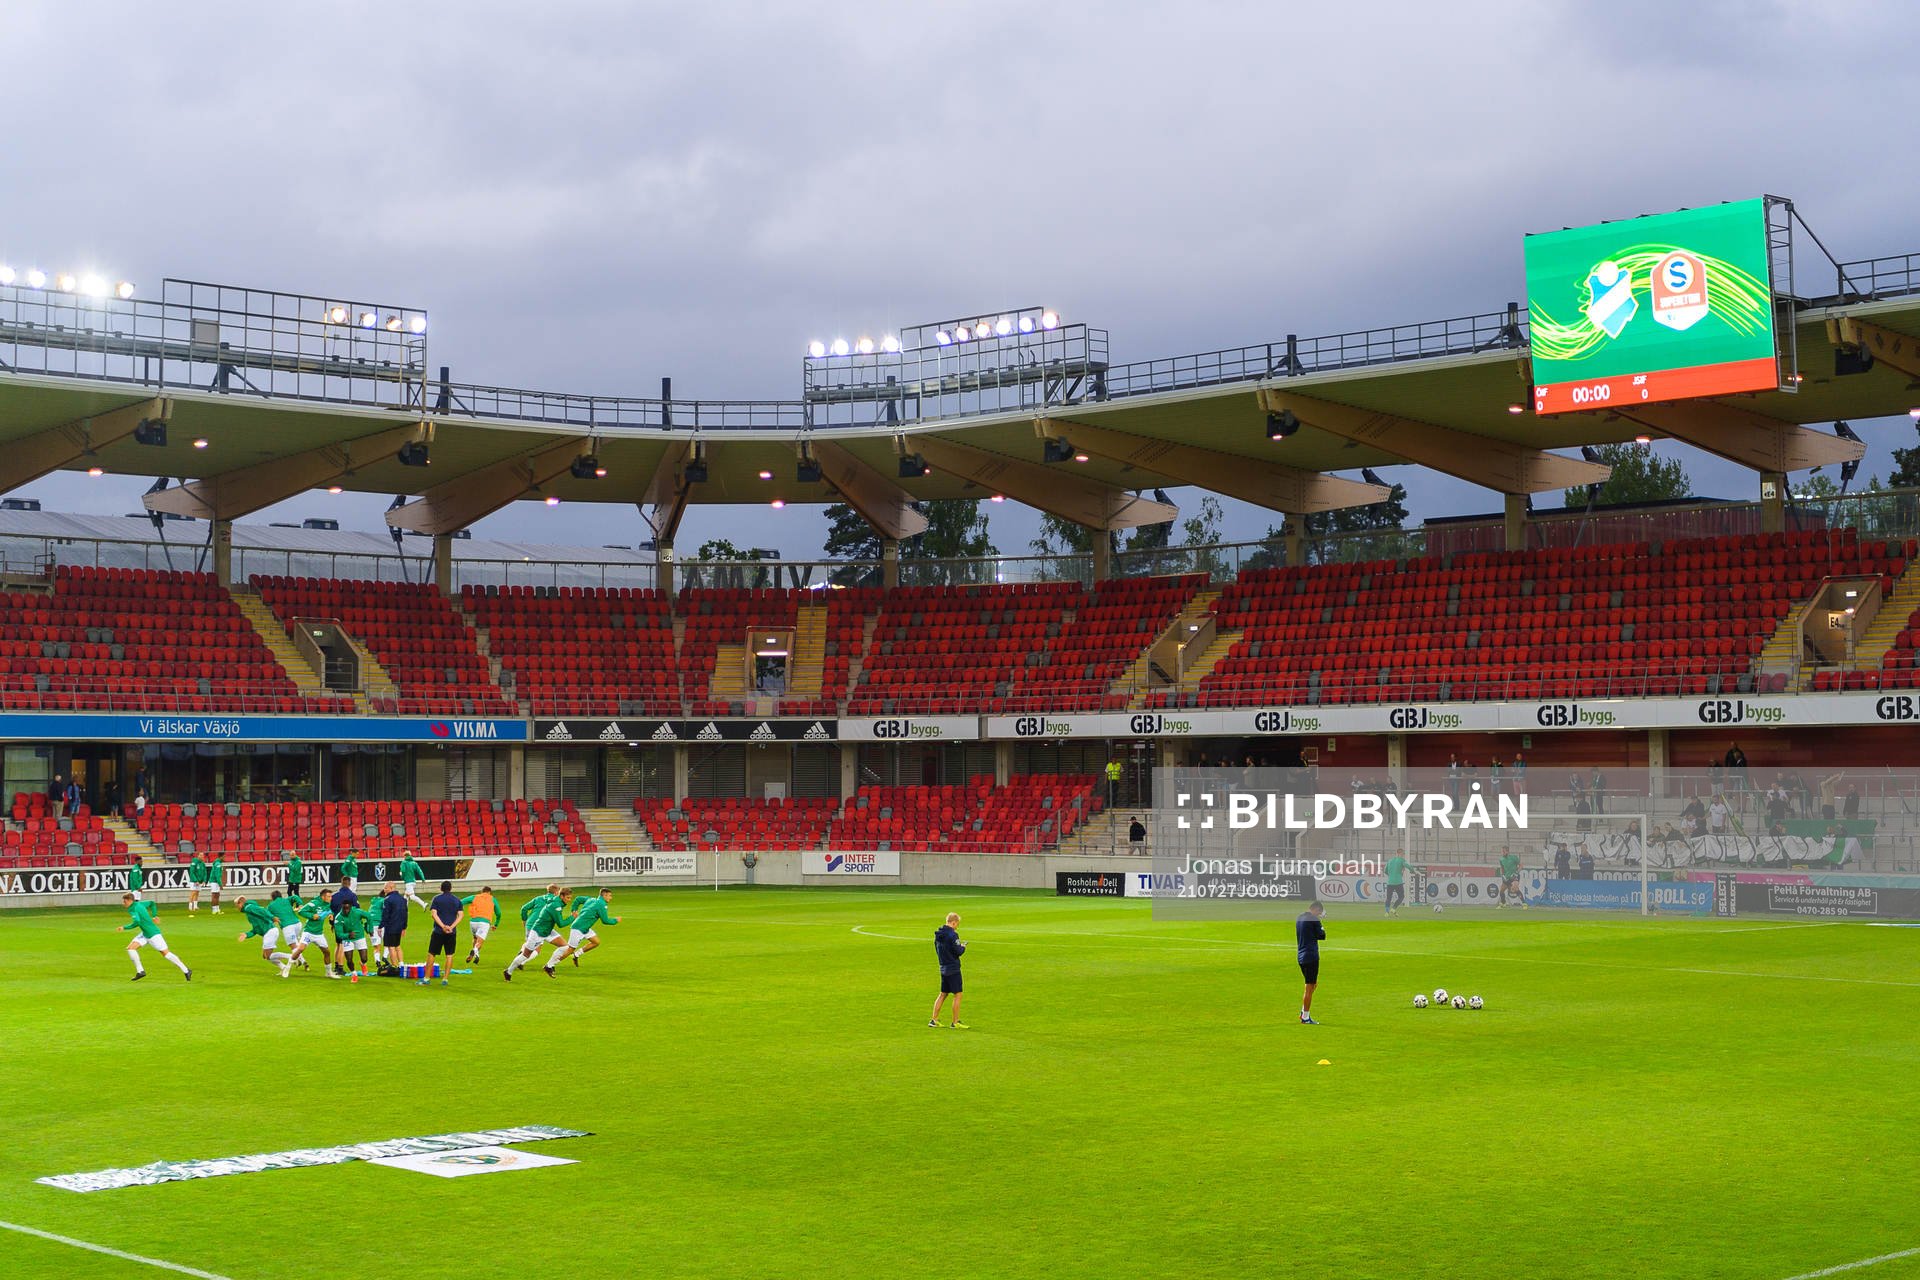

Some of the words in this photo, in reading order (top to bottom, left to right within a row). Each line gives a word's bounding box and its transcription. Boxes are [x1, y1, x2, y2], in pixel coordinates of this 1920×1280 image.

[1572, 384, 1610, 403] 00:00
[1641, 389, 1648, 399] 0
[1537, 401, 1543, 411] 0
[1390, 708, 1427, 728] GBJ
[1429, 710, 1462, 728] bygg.
[1537, 705, 1577, 726] GBJ
[1580, 708, 1616, 725] bygg.
[1699, 700, 1743, 723] GBJ
[1746, 704, 1786, 722] bygg.
[140, 720, 153, 733] Vi
[158, 720, 200, 733] älskar
[203, 720, 240, 736] Växjö
[1015, 717, 1045, 736] GBJ
[1046, 720, 1072, 736] bygg.
[1130, 715, 1162, 734] GBJ
[1164, 718, 1192, 733] bygg.
[1255, 711, 1289, 731] GBJ
[1291, 715, 1321, 731] bygg.
[454, 722, 497, 738] VISMA
[546, 731, 572, 740] adidas
[599, 731, 625, 740] adidas
[652, 731, 677, 740] adidas
[696, 731, 722, 740] adidas
[750, 731, 776, 740] adidas
[803, 731, 830, 740] adidas
[873, 720, 908, 739] GBJ
[911, 723, 942, 738] bygg.
[596, 856, 653, 875] ecosign
[845, 854, 875, 864] INTER
[513, 861, 538, 873] VIDA
[845, 864, 875, 873] SPORT
[31, 873, 79, 893] OCH
[84, 871, 130, 891] DEN
[226, 866, 330, 887] IDROTEN
[1138, 874, 1184, 890] TIVAB
[1324, 883, 1344, 893] KIA
[1774, 886, 1798, 895] PeHå
[1800, 886, 1855, 899] Förvaltning
[1857, 888, 1872, 898] AB
[1631, 888, 1706, 906] mnBOLL.se
[1797, 906, 1836, 916] 0470-285
[1837, 907, 1848, 916] 90
